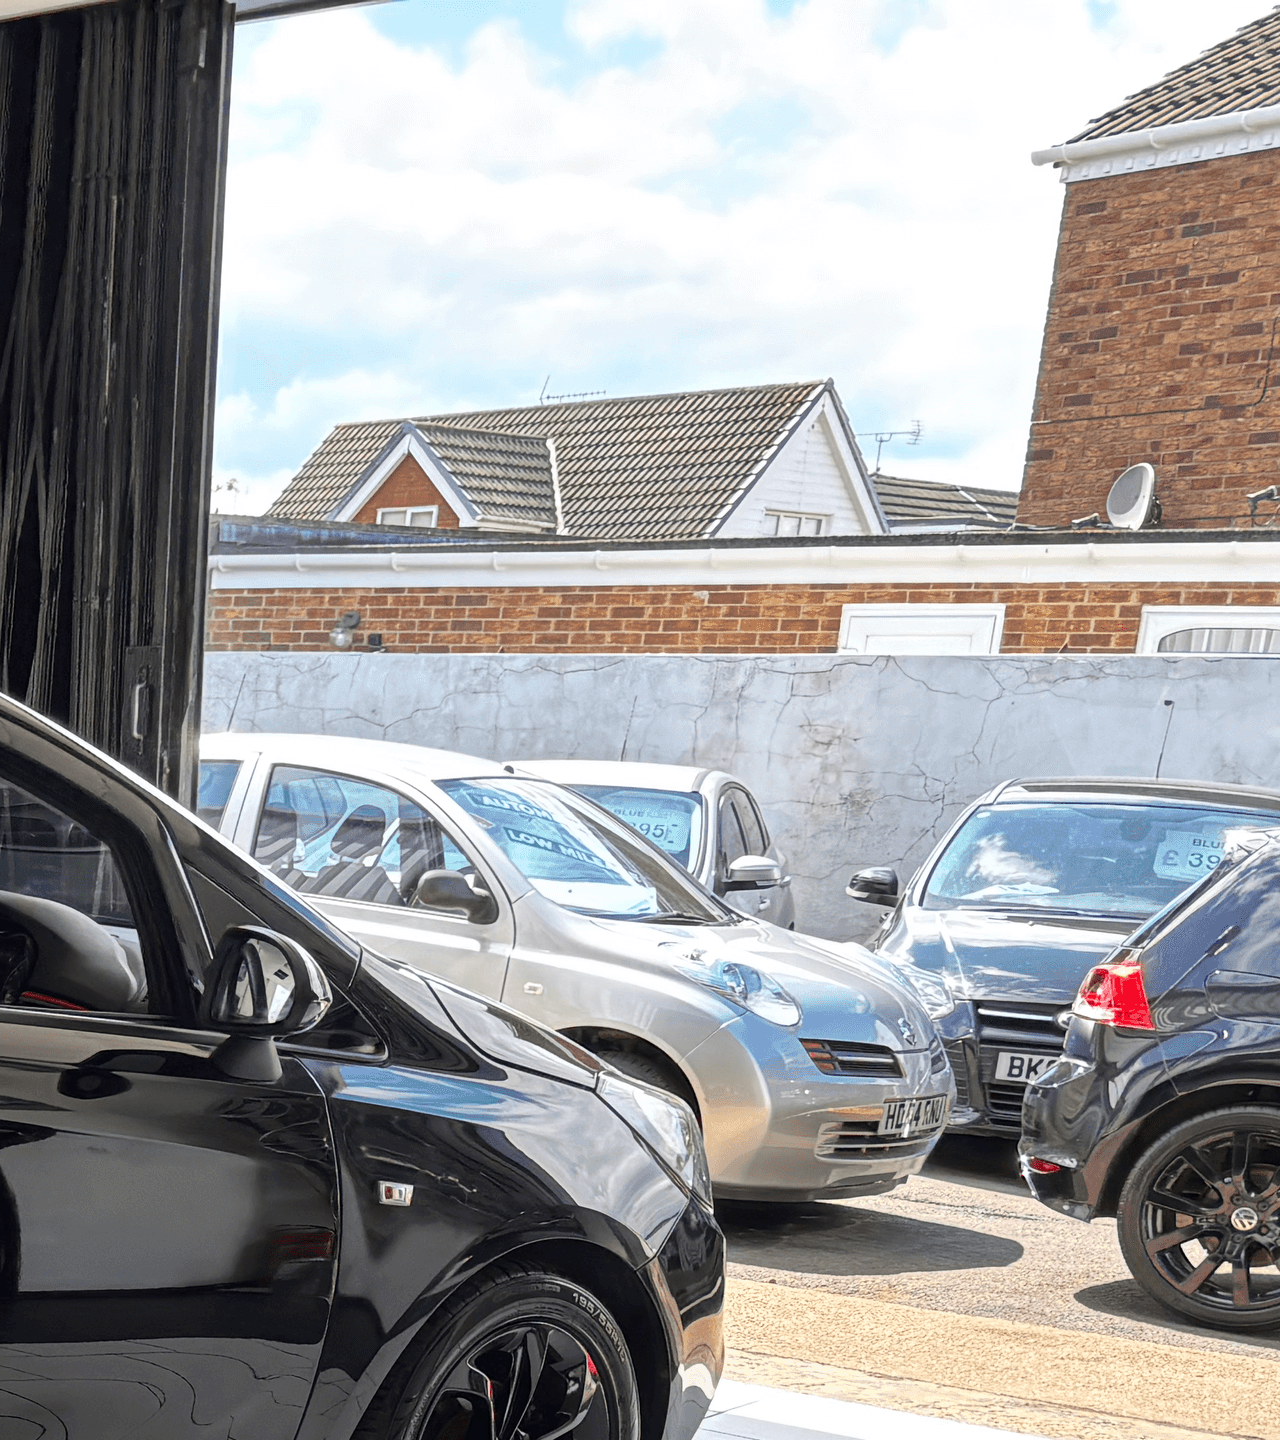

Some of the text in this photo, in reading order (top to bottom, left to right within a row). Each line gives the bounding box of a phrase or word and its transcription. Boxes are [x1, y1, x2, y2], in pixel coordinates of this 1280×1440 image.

[508, 829, 552, 849] LOW
[1192, 838, 1224, 849] BLU
[1007, 1055, 1057, 1079] BK
